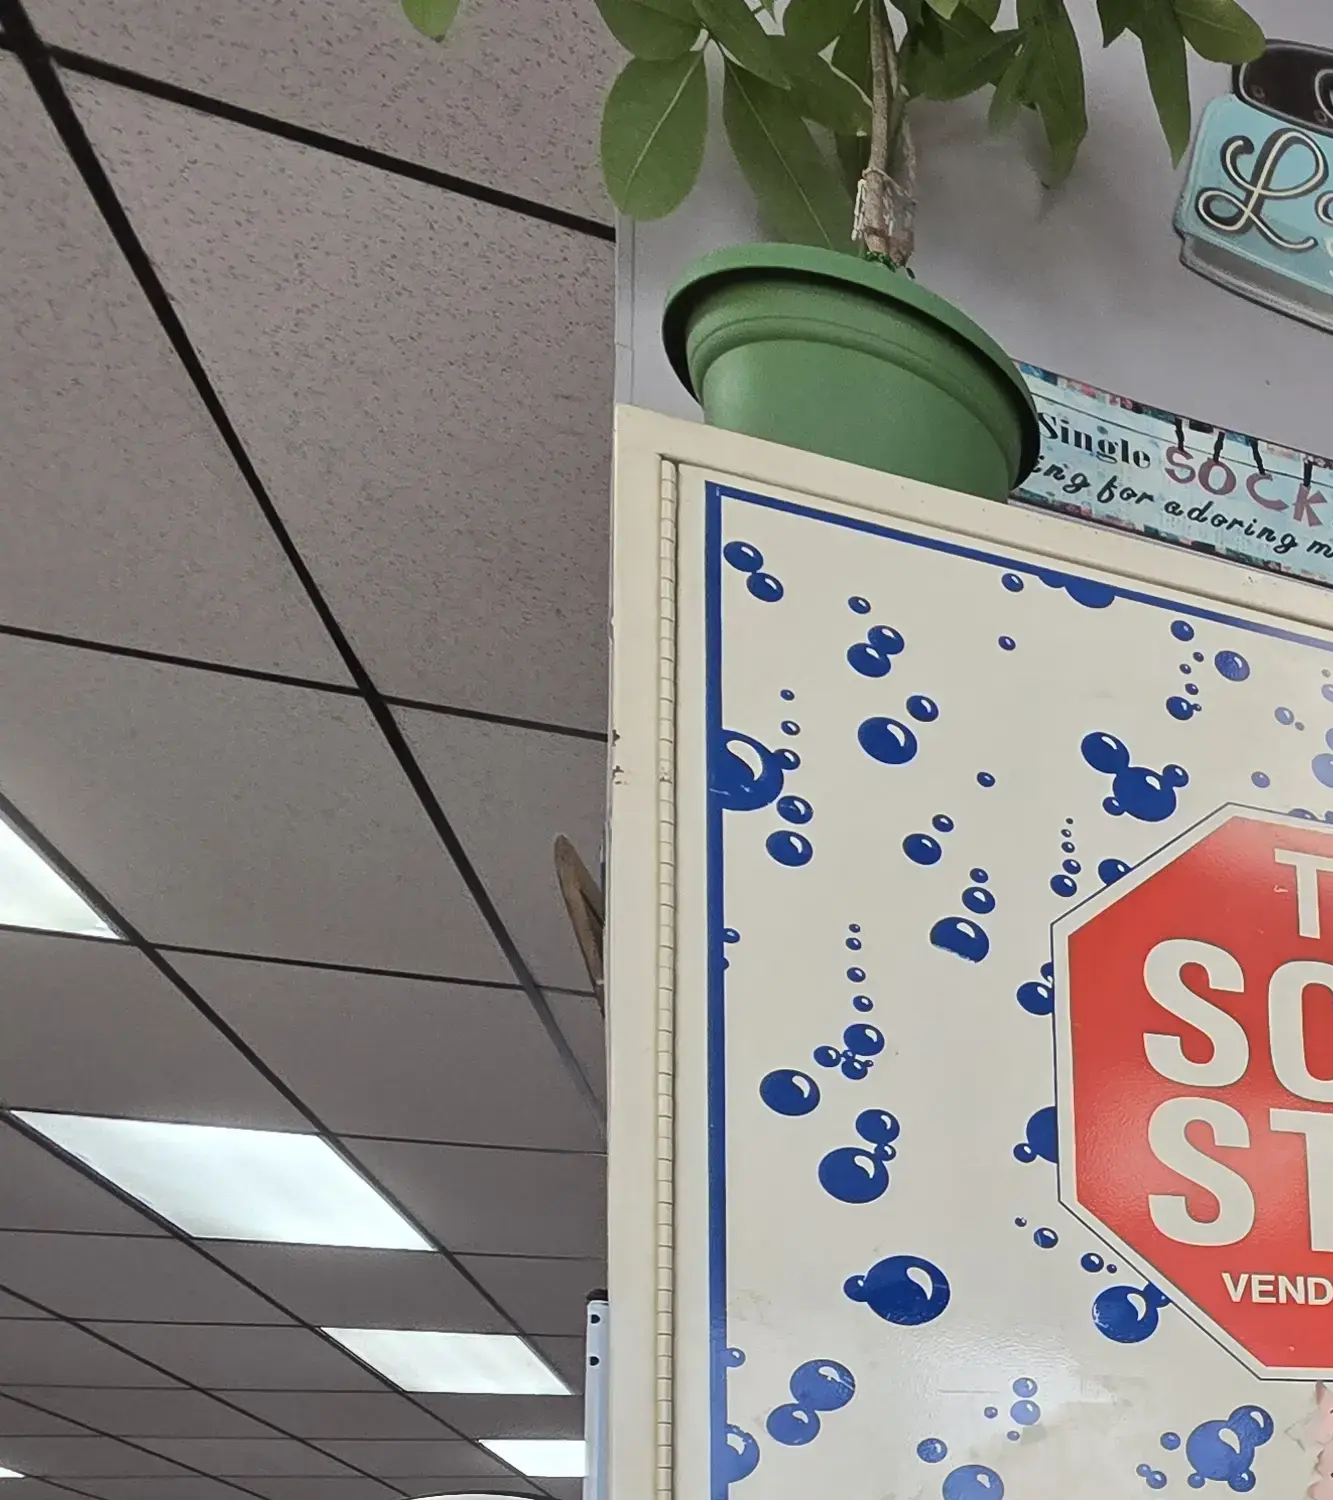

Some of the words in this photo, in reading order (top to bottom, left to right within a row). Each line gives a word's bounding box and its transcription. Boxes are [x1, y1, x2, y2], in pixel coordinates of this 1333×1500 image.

[1037, 411, 1151, 470] Single
[1031, 454, 1090, 494] ing
[1096, 474, 1156, 504] for
[1164, 498, 1298, 553] adoring
